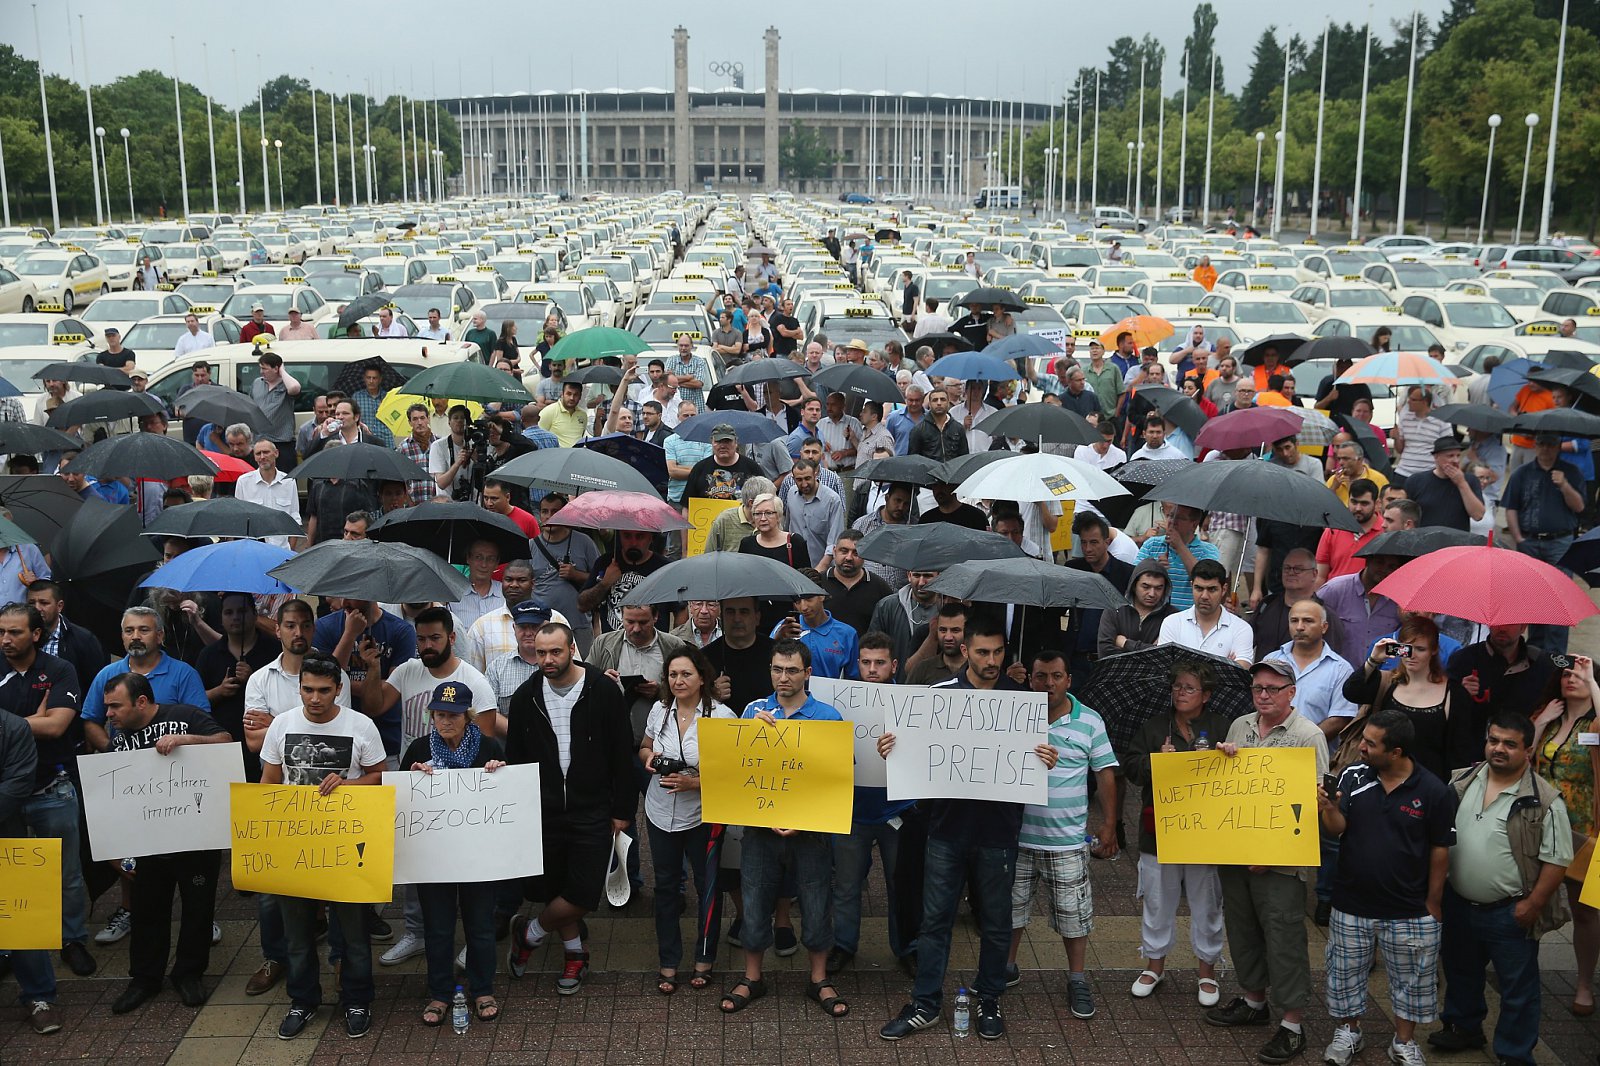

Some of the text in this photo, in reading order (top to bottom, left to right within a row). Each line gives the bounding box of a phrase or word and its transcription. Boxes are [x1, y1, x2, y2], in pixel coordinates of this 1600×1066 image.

[1187, 755, 1276, 778] FAIRER
[409, 771, 498, 802] KEINE
[743, 775, 792, 792] ALLE
[1158, 778, 1286, 805] WETTBEWERB
[263, 789, 357, 813] FAIRER
[756, 796, 775, 810] DA
[234, 819, 365, 840] WETTBEWERB
[394, 803, 518, 838] ABZOCKE
[1160, 812, 1208, 835] FÜR
[241, 851, 279, 875] FÜR
